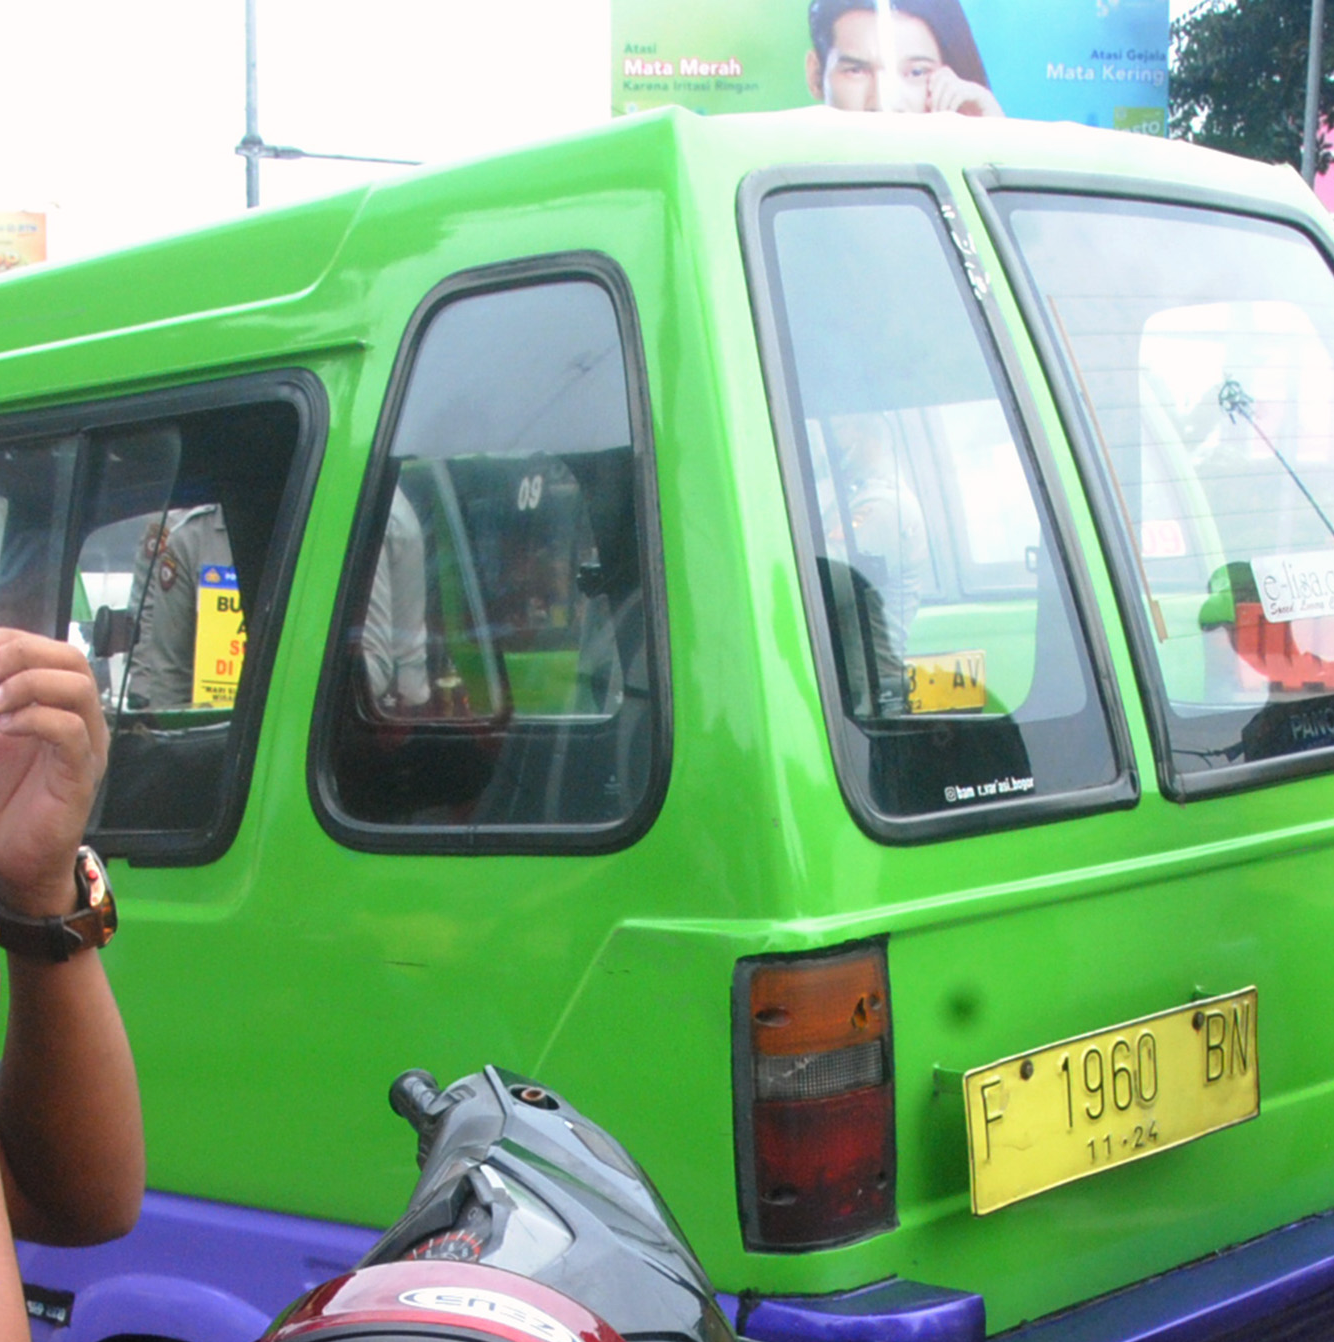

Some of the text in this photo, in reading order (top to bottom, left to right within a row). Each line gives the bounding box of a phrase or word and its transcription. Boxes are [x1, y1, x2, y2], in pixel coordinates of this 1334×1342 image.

[624, 43, 657, 54] Atasi
[1091, 49, 1166, 62] Atasi Gejala
[623, 56, 743, 76] Mata Merah
[1047, 63, 1165, 87] Mata Kering
[623, 80, 759, 94] Karena Iritasi Ringan
[216, 659, 234, 676] DI
[980, 1000, 1251, 1162] F 1960 BN
